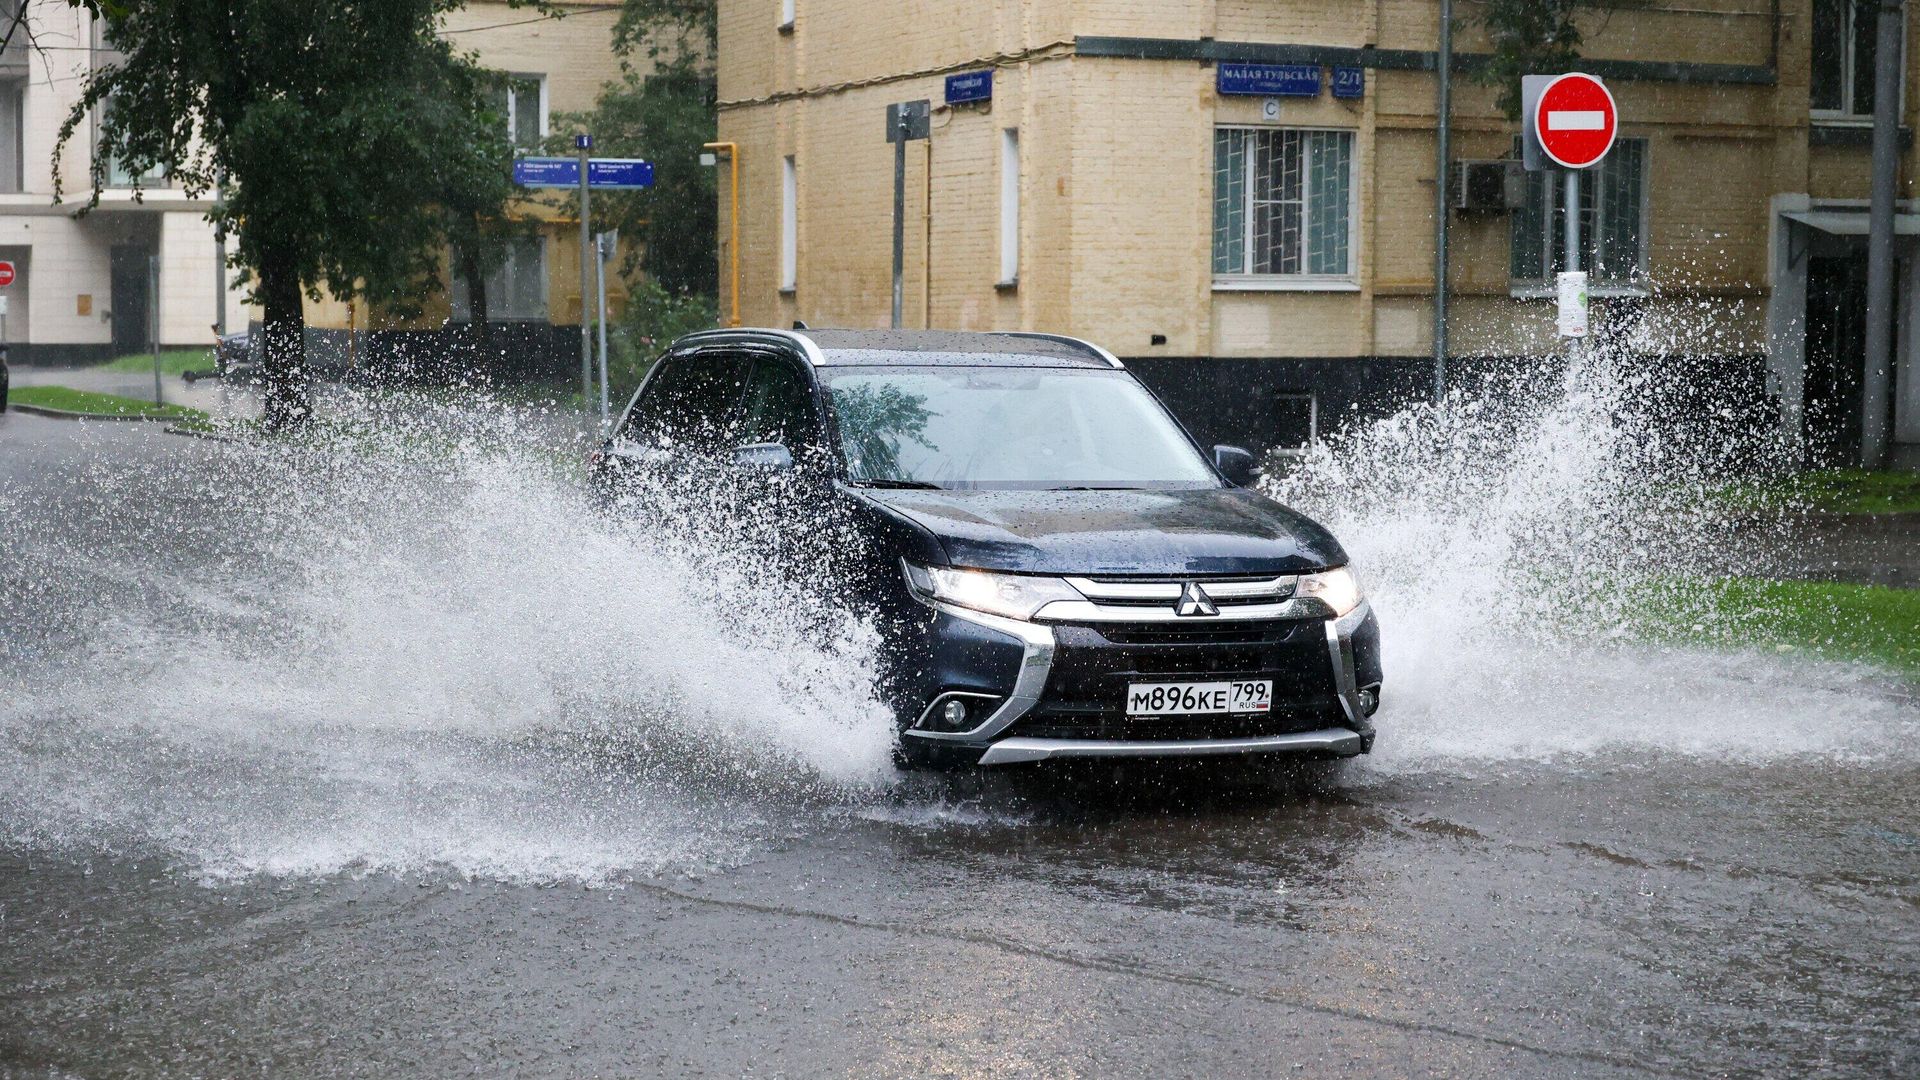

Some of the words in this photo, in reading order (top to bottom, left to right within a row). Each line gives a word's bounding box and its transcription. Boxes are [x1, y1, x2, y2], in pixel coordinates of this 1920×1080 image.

[1224, 69, 1261, 79] МАЛАЯ
[1264, 70, 1319, 81] ТУЛЬСКАЯ
[1338, 71, 1360, 85] 2/1
[1134, 686, 1227, 711] М896КЕ
[1232, 683, 1266, 702] 799
